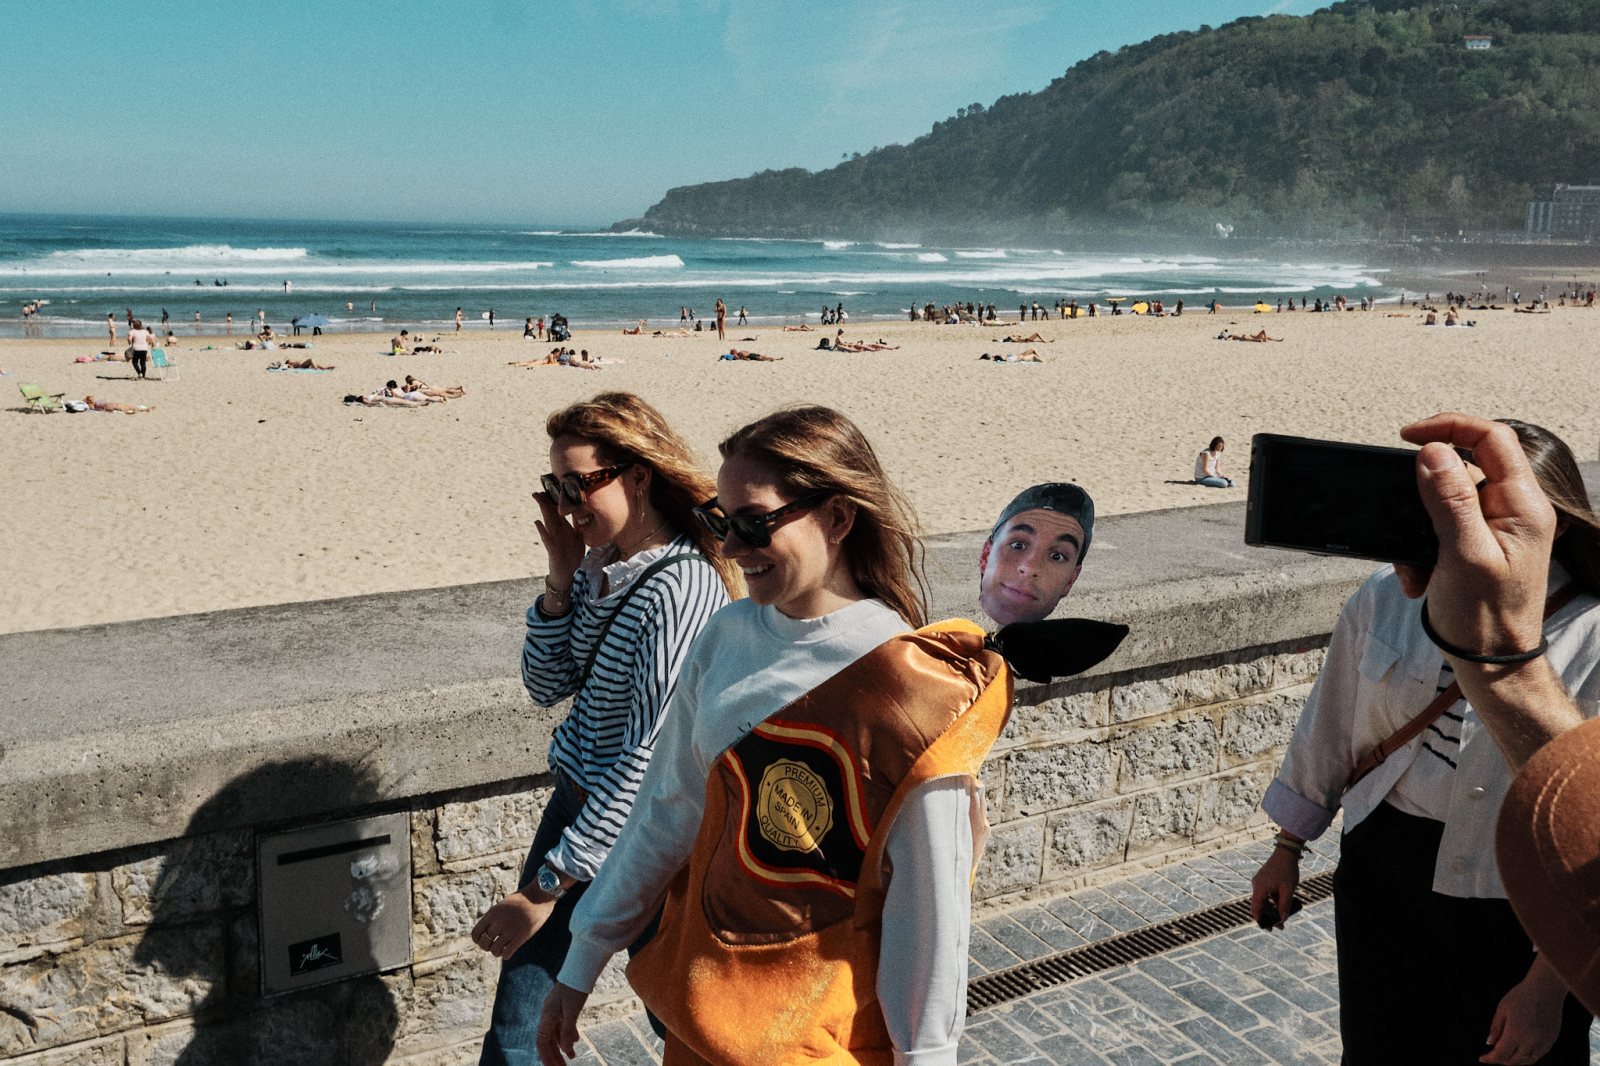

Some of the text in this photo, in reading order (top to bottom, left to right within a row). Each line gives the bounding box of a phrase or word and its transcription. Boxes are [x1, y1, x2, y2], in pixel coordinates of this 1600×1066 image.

[775, 785, 813, 821] MADE IN
[785, 766, 826, 807] PREMIUM
[761, 815, 798, 847] QUALITY
[774, 801, 800, 830] SPAIN
